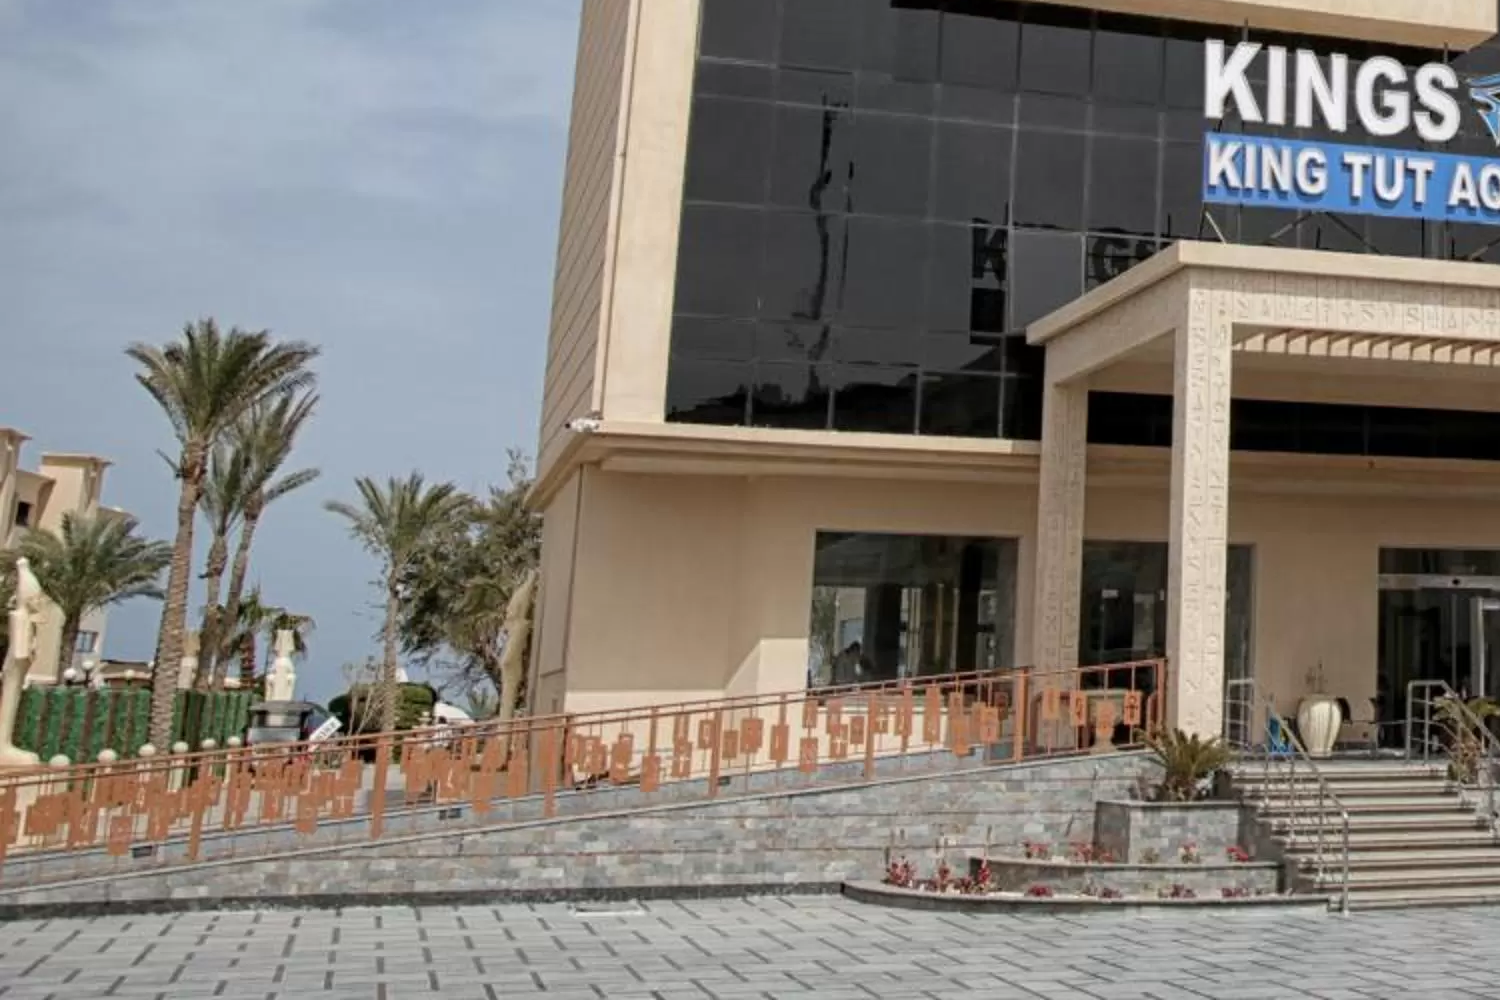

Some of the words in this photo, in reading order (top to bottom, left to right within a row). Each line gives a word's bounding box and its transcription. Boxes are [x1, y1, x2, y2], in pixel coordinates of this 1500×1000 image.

[1205, 38, 1461, 142] KINGS
[1208, 140, 1328, 195] KING
[1343, 152, 1435, 204] TUT
